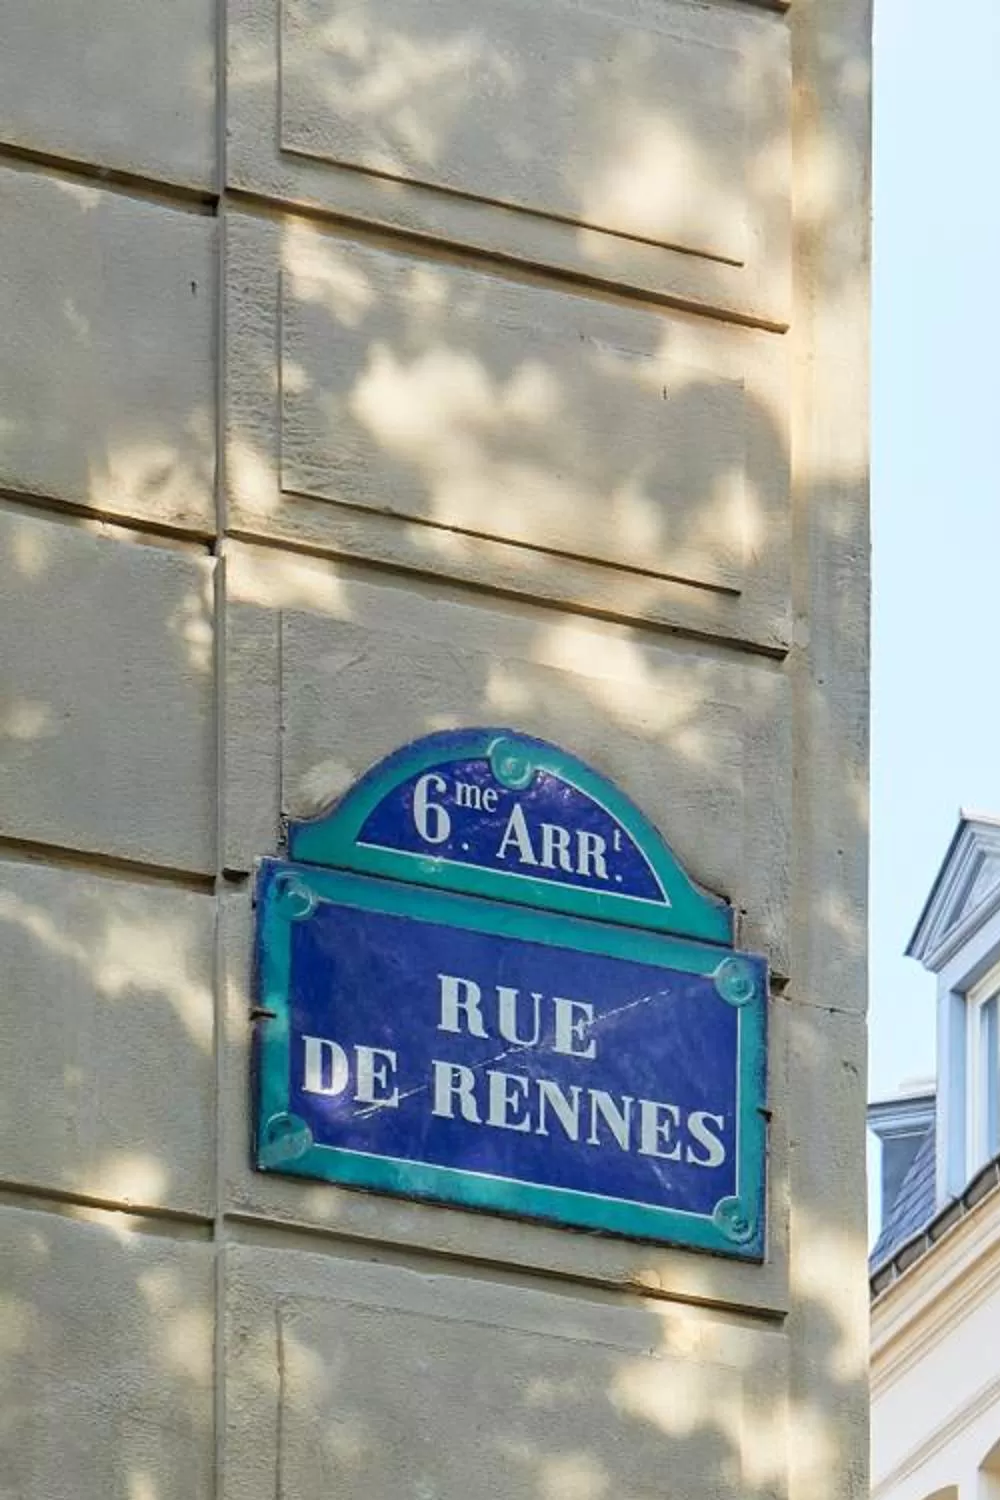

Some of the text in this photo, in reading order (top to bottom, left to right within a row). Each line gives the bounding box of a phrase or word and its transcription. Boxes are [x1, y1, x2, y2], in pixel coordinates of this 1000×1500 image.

[437, 973, 596, 1059] RUE
[301, 1034, 726, 1167] DE RENNES
